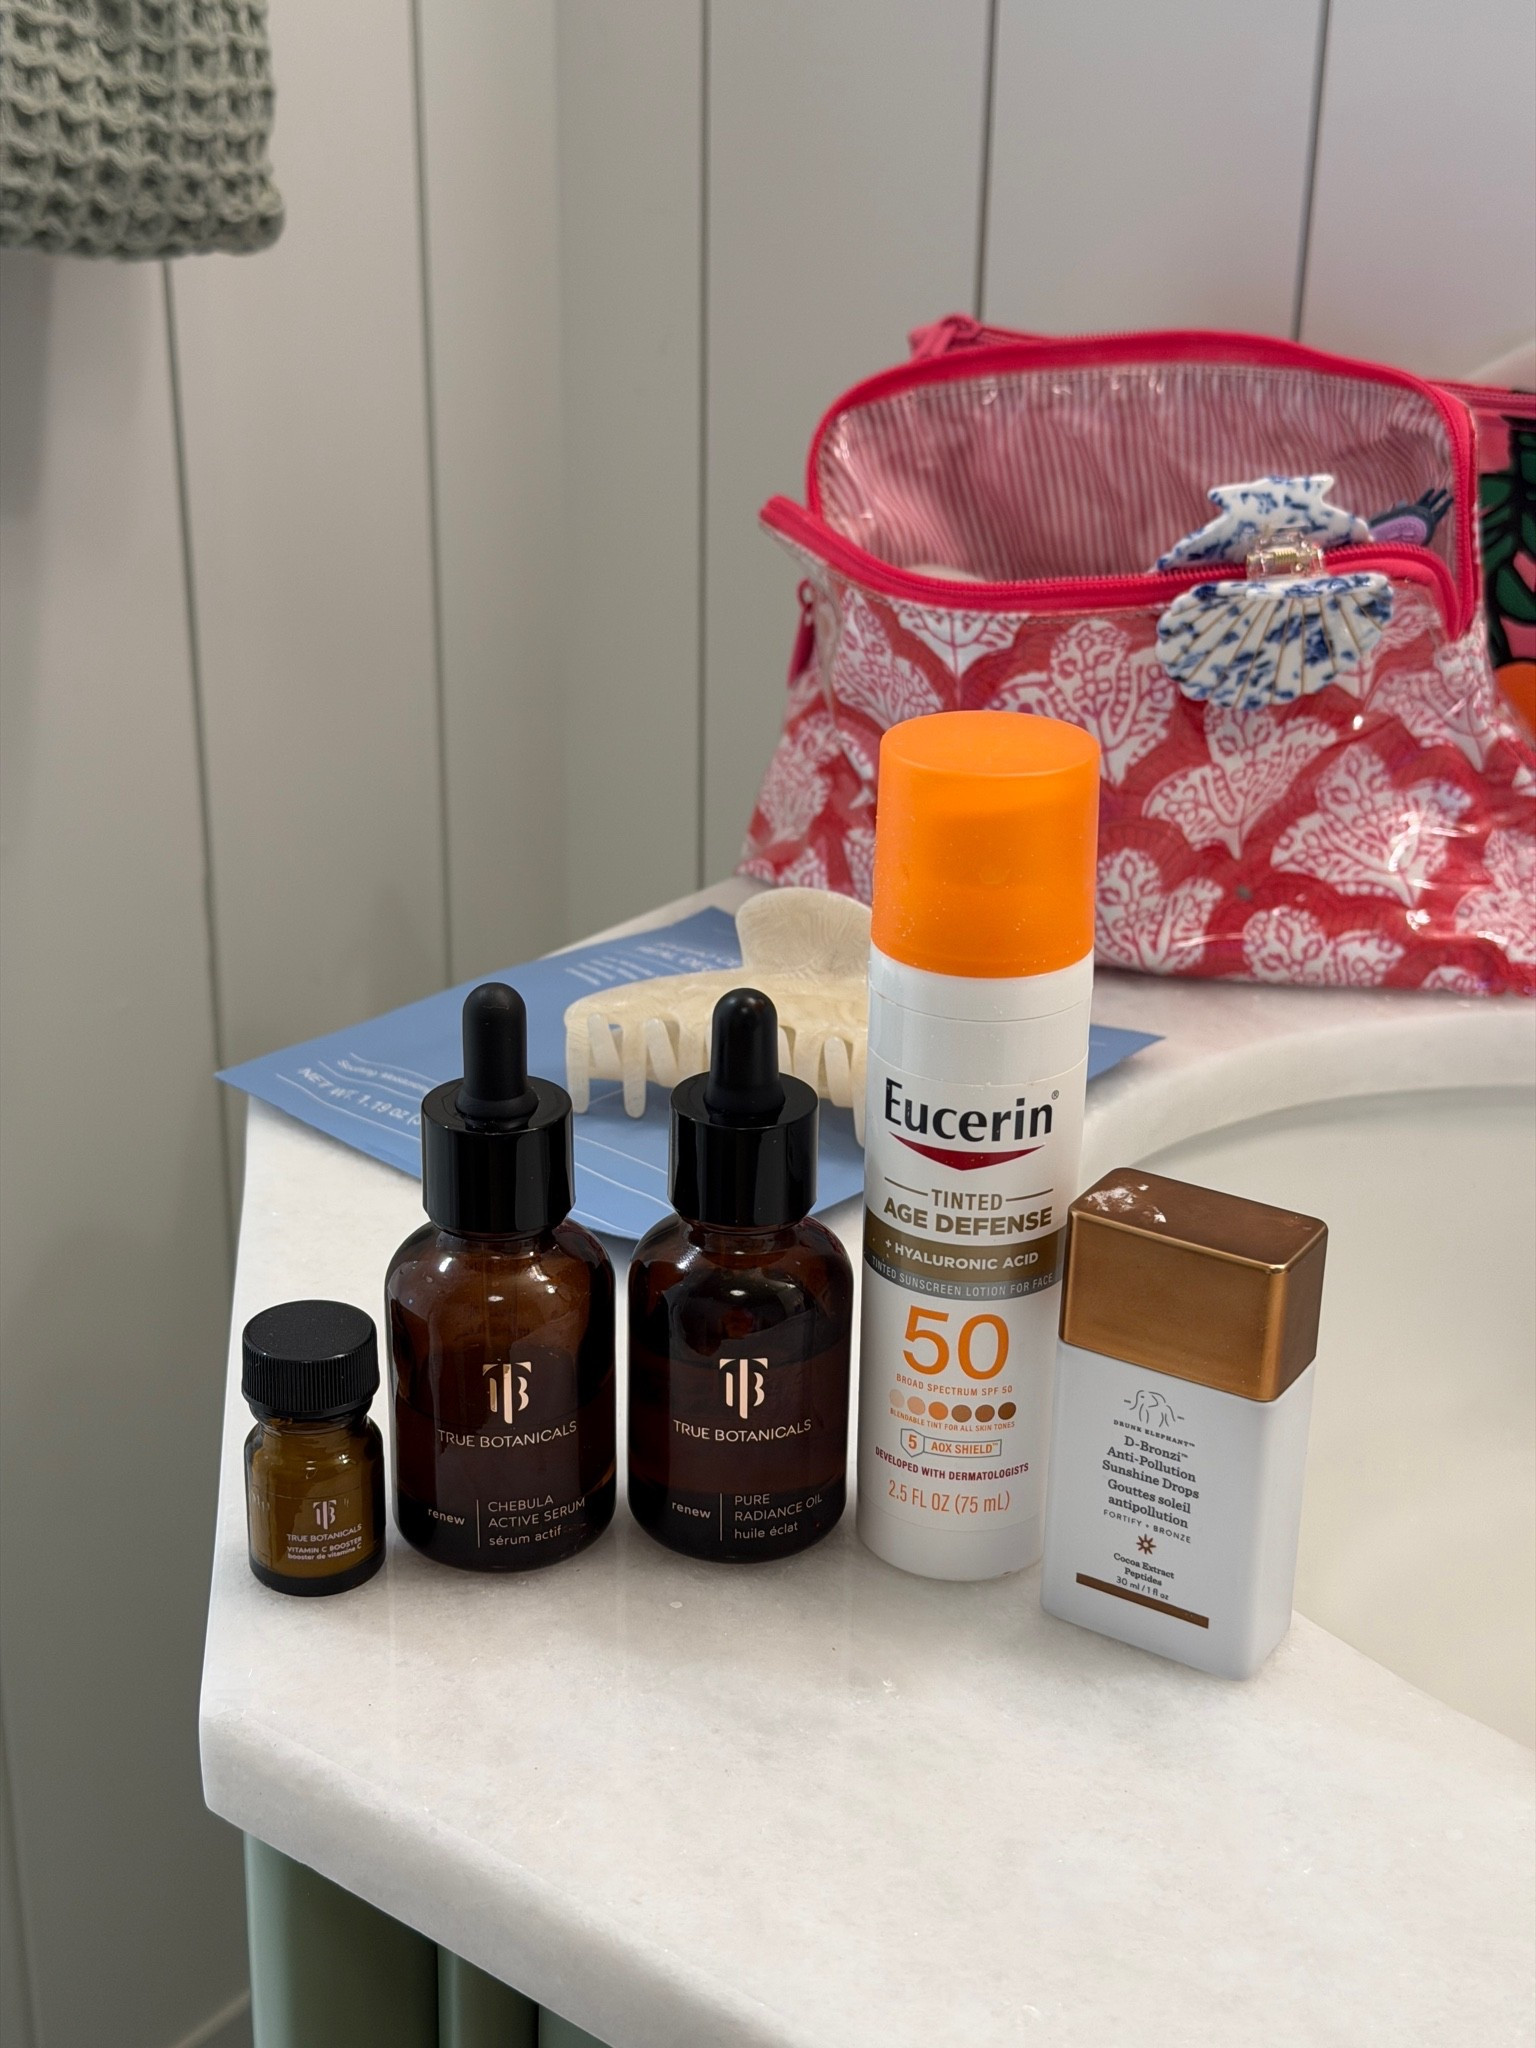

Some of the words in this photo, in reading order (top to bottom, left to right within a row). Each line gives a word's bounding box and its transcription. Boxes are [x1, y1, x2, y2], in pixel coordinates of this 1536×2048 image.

[931, 1188, 1003, 1211] TINTED
[884, 1197, 928, 1230] AGE
[935, 1206, 1053, 1236] DEFENSE
[895, 1243, 998, 1271] HYALURONIC
[1002, 1251, 1039, 1270] ACID
[871, 1255, 897, 1279] TINTED
[899, 1272, 962, 1297] SUNSCREEN
[965, 1285, 1006, 1298] LOTION
[1010, 1281, 1030, 1294] FOR
[1032, 1272, 1054, 1289] FACE
[903, 1305, 1009, 1380] 50
[896, 1373, 924, 1390] BROAD
[927, 1383, 978, 1396] SPECTRUM
[981, 1386, 999, 1396] SPF
[1001, 1384, 1013, 1394] 50
[673, 1419, 710, 1440] TRUE
[715, 1419, 812, 1443] BOTANICALS
[890, 1407, 925, 1426] BLENDABLE
[926, 1420, 942, 1430] TINT
[944, 1423, 958, 1431] FOR
[975, 1424, 992, 1432] SKIN
[994, 1421, 1016, 1430] TONES
[1113, 1419, 1142, 1432] DRUNK
[437, 1429, 475, 1448] TRUE
[480, 1420, 577, 1448] BOTANICALS
[908, 1434, 918, 1450] 5
[931, 1441, 952, 1453] AOX
[875, 1446, 919, 1473] DEVELOPED
[921, 1466, 946, 1479] WITH
[948, 1462, 1030, 1481] DERMATOLOGISTS
[1106, 1446, 1196, 1483] Anti-Pollution
[1102, 1459, 1159, 1485] Sunshine
[1162, 1477, 1200, 1499] Drops
[488, 1495, 554, 1512] CHEBULA
[734, 1494, 770, 1506] PURE
[734, 1502, 802, 1521] RADIANCE
[806, 1493, 823, 1508] OIL
[888, 1479, 907, 1502] 2.5
[911, 1487, 927, 1508] FL
[931, 1492, 950, 1512] OZ
[954, 1493, 978, 1515] (75
[983, 1490, 1011, 1512] mL)
[1107, 1478, 1156, 1502] Gouttes
[1157, 1495, 1191, 1514] soleil
[428, 1508, 465, 1526] renew
[488, 1513, 540, 1528] ACTIVE
[543, 1497, 586, 1522] SERUM
[671, 1502, 711, 1518] renew
[1108, 1495, 1189, 1529] antipollution
[286, 1533, 308, 1542] TRUE
[310, 1523, 362, 1543] BOTANICALS
[489, 1533, 530, 1546] sérum
[535, 1524, 562, 1541] actif
[734, 1528, 765, 1539] huile
[769, 1521, 798, 1536] éclat
[1103, 1509, 1142, 1527] FORTIFY
[1153, 1525, 1191, 1544] BRONZE
[287, 1546, 319, 1554] VITAMIN
[329, 1536, 362, 1551] BOOSTER
[288, 1552, 315, 1560] booster
[327, 1546, 356, 1558] vitamine
[357, 1542, 362, 1550] C
[1113, 1552, 1141, 1568] Cocoa
[1142, 1561, 1175, 1579] Extract
[1124, 1567, 1162, 1586] Peptides
[1116, 1576, 1128, 1586] 30
[1129, 1581, 1140, 1590] ml
[1152, 1587, 1159, 1596] fl
[1160, 1592, 1169, 1600] oz
